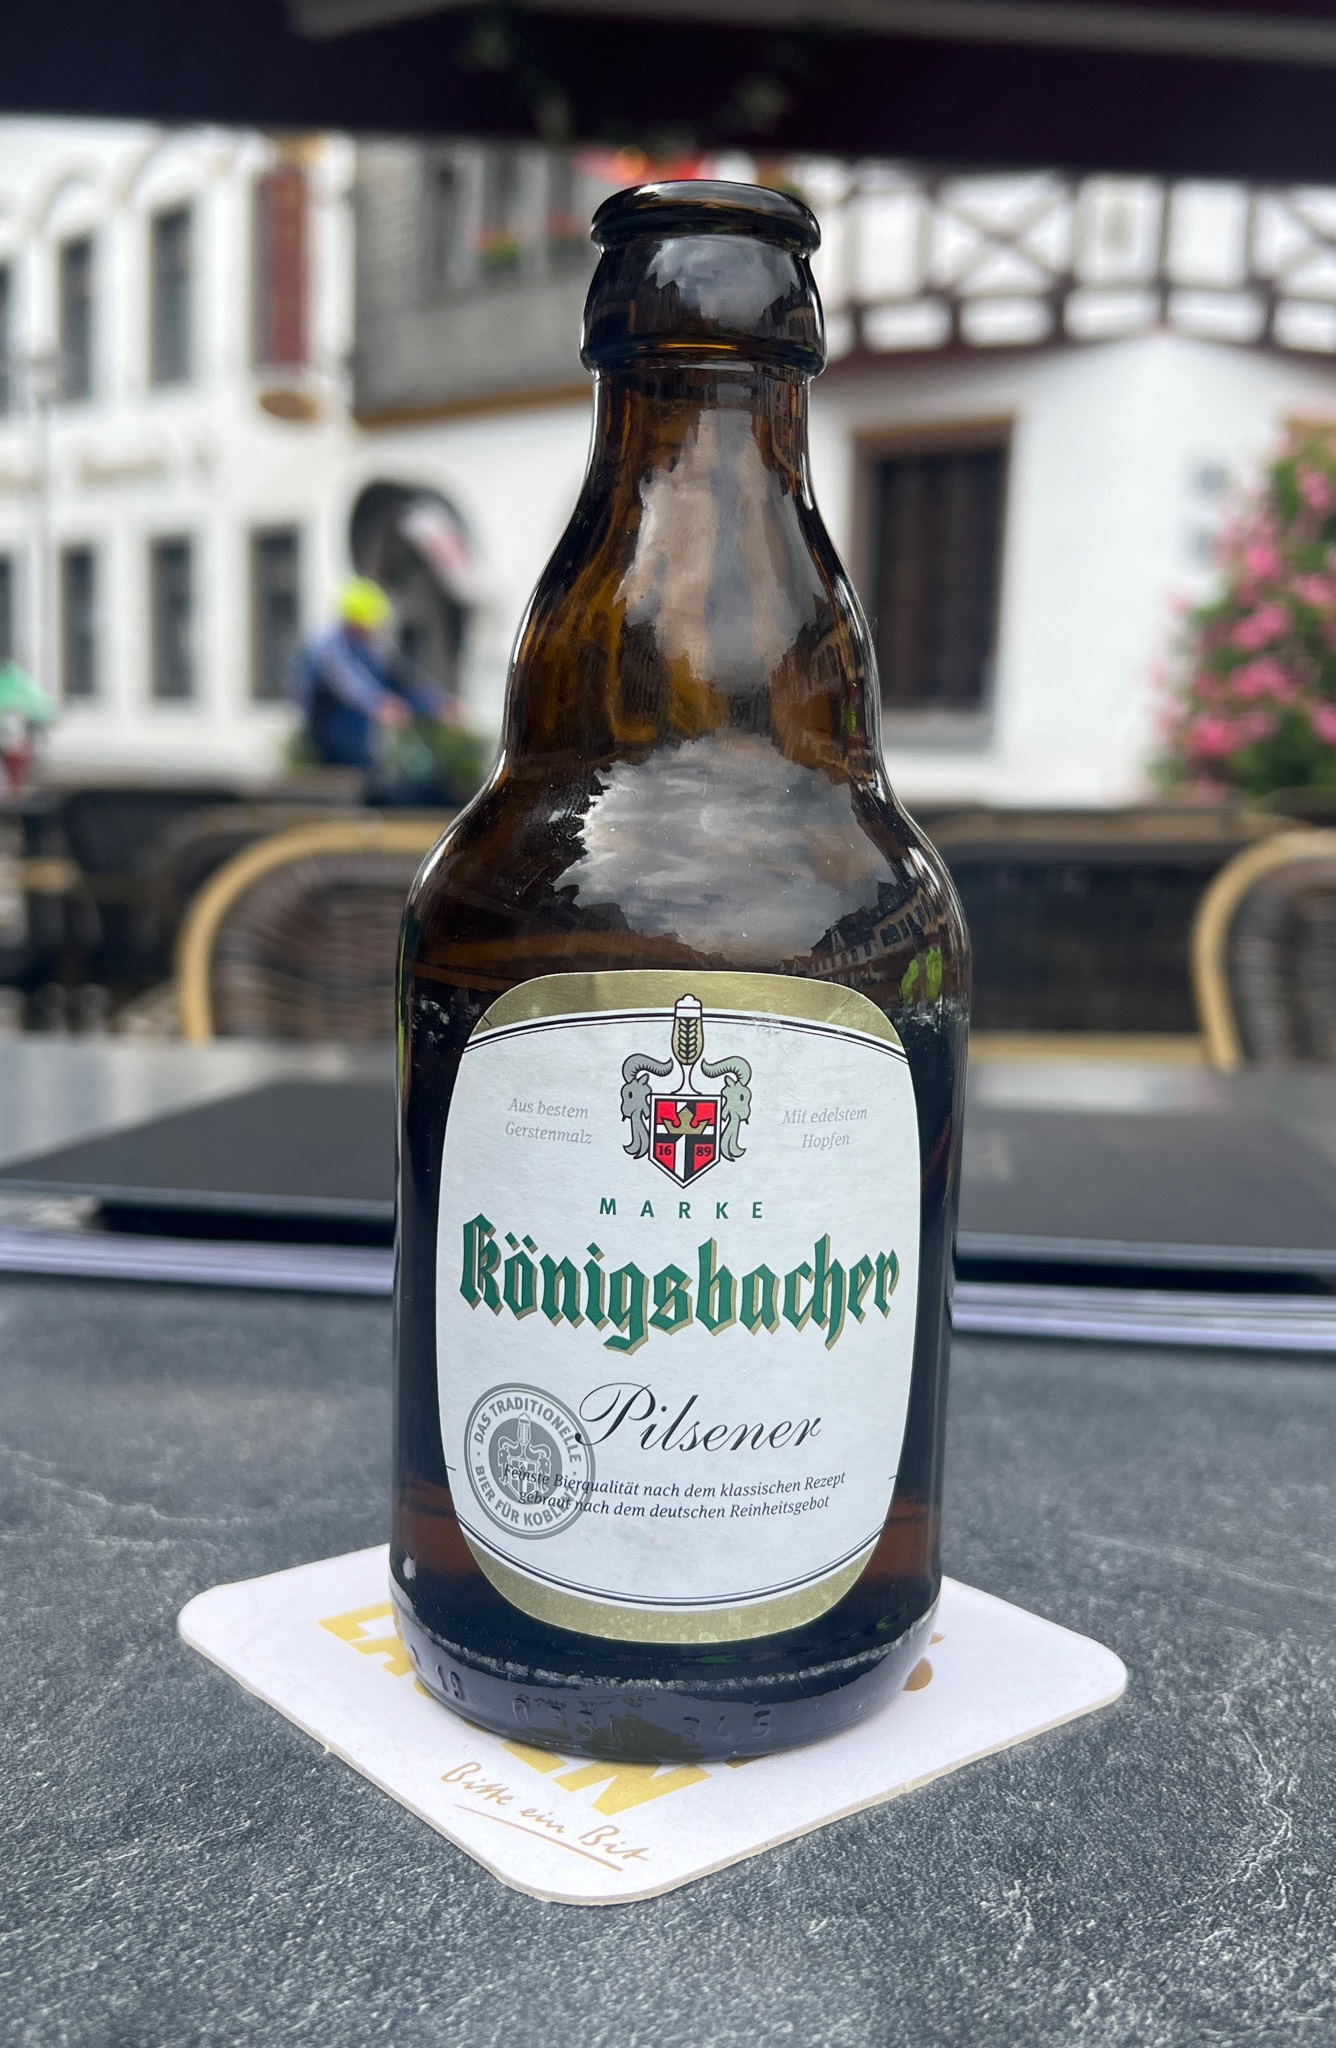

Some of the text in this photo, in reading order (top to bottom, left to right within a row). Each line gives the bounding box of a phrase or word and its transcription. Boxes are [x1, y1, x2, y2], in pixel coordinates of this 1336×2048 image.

[508, 1098, 589, 1119] Aus bestem
[782, 1106, 868, 1125] Mit edelstem
[505, 1121, 593, 1144] Gerstenmalz
[801, 1132, 850, 1150] Hopfen
[657, 1145, 712, 1157] 16 89
[599, 1197, 763, 1219] MARKE
[459, 1212, 900, 1356] Königsbacher
[474, 1396, 582, 1463] DAS TRADITIONELLE
[574, 1382, 822, 1452] Pilsener
[475, 1465, 496, 1502] BIER
[494, 1501, 520, 1524] FÜR
[504, 1463, 847, 1498] Feinste Bierqualität nach dem klassischen Rezept
[518, 1490, 831, 1519] gebraut nach dem deutschen Reinheitsgebot
[440, 1761, 515, 1806] Bitte
[519, 1807, 565, 1834] ein
[578, 1825, 651, 1862] Bit
